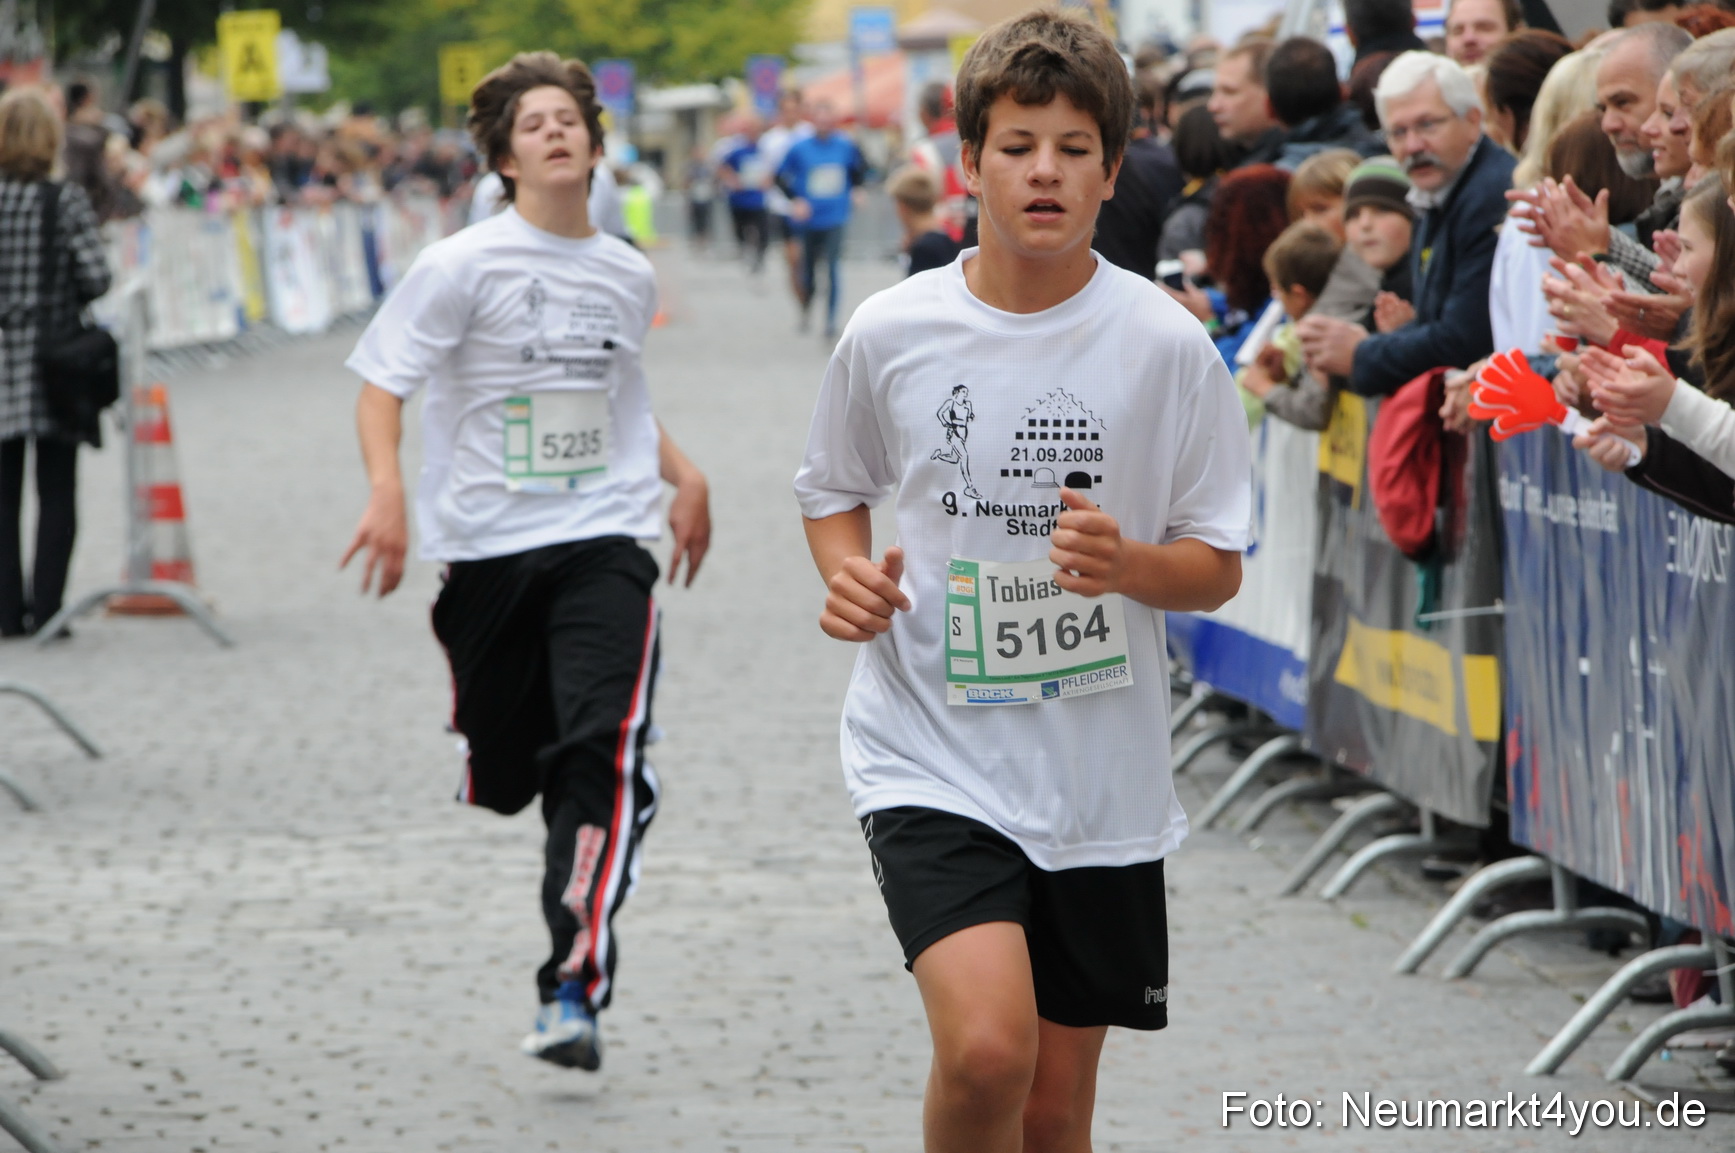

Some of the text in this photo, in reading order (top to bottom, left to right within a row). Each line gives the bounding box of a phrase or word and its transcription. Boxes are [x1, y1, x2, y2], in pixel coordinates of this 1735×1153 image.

[542, 429, 602, 460] 5235
[1011, 447, 1104, 462] 21.09.2008
[942, 492, 967, 517] 9.
[987, 576, 1062, 602] Tobias
[952, 616, 962, 636] S
[996, 604, 1111, 658] 5164
[1061, 665, 1128, 689] PFLEIDERER
[966, 688, 1014, 699] BOCK
